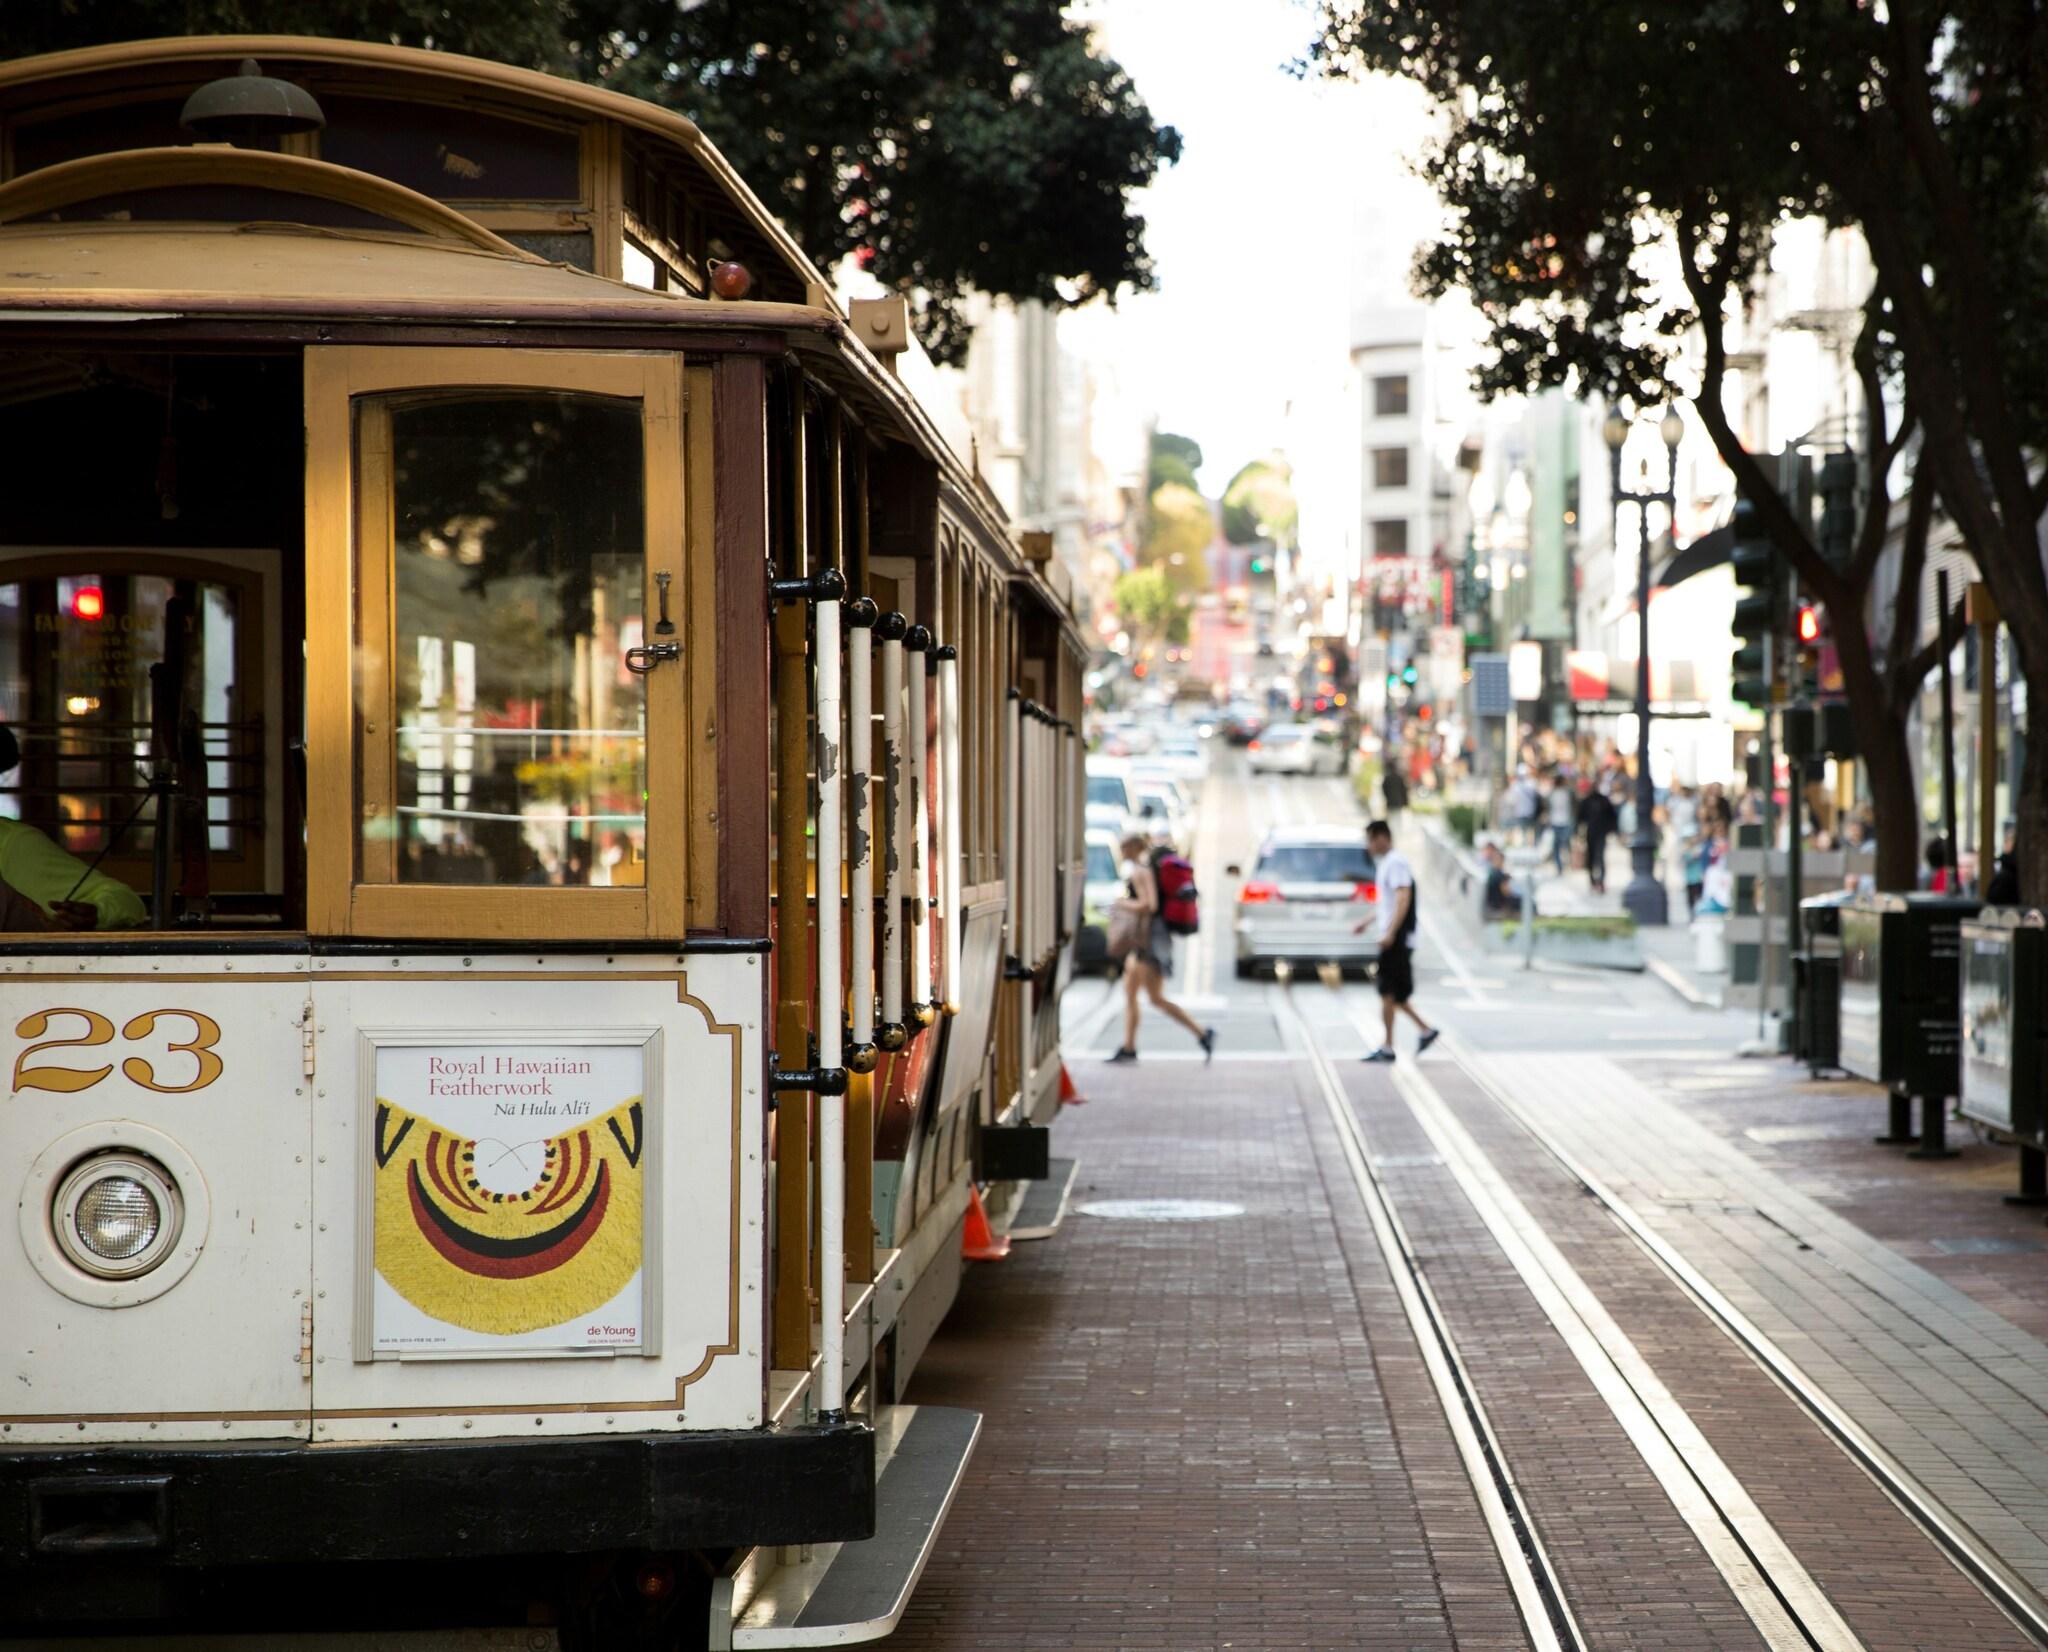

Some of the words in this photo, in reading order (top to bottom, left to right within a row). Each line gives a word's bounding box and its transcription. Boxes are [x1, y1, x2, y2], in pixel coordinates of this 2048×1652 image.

[12, 1007, 224, 1093] 23
[429, 1056, 485, 1080] Royal
[496, 1057, 591, 1074] Hawaiian
[429, 1077, 553, 1096] Featherwork
[521, 1100, 557, 1116] Hulu
[587, 1326, 601, 1336] de
[602, 1326, 636, 1337] Young
